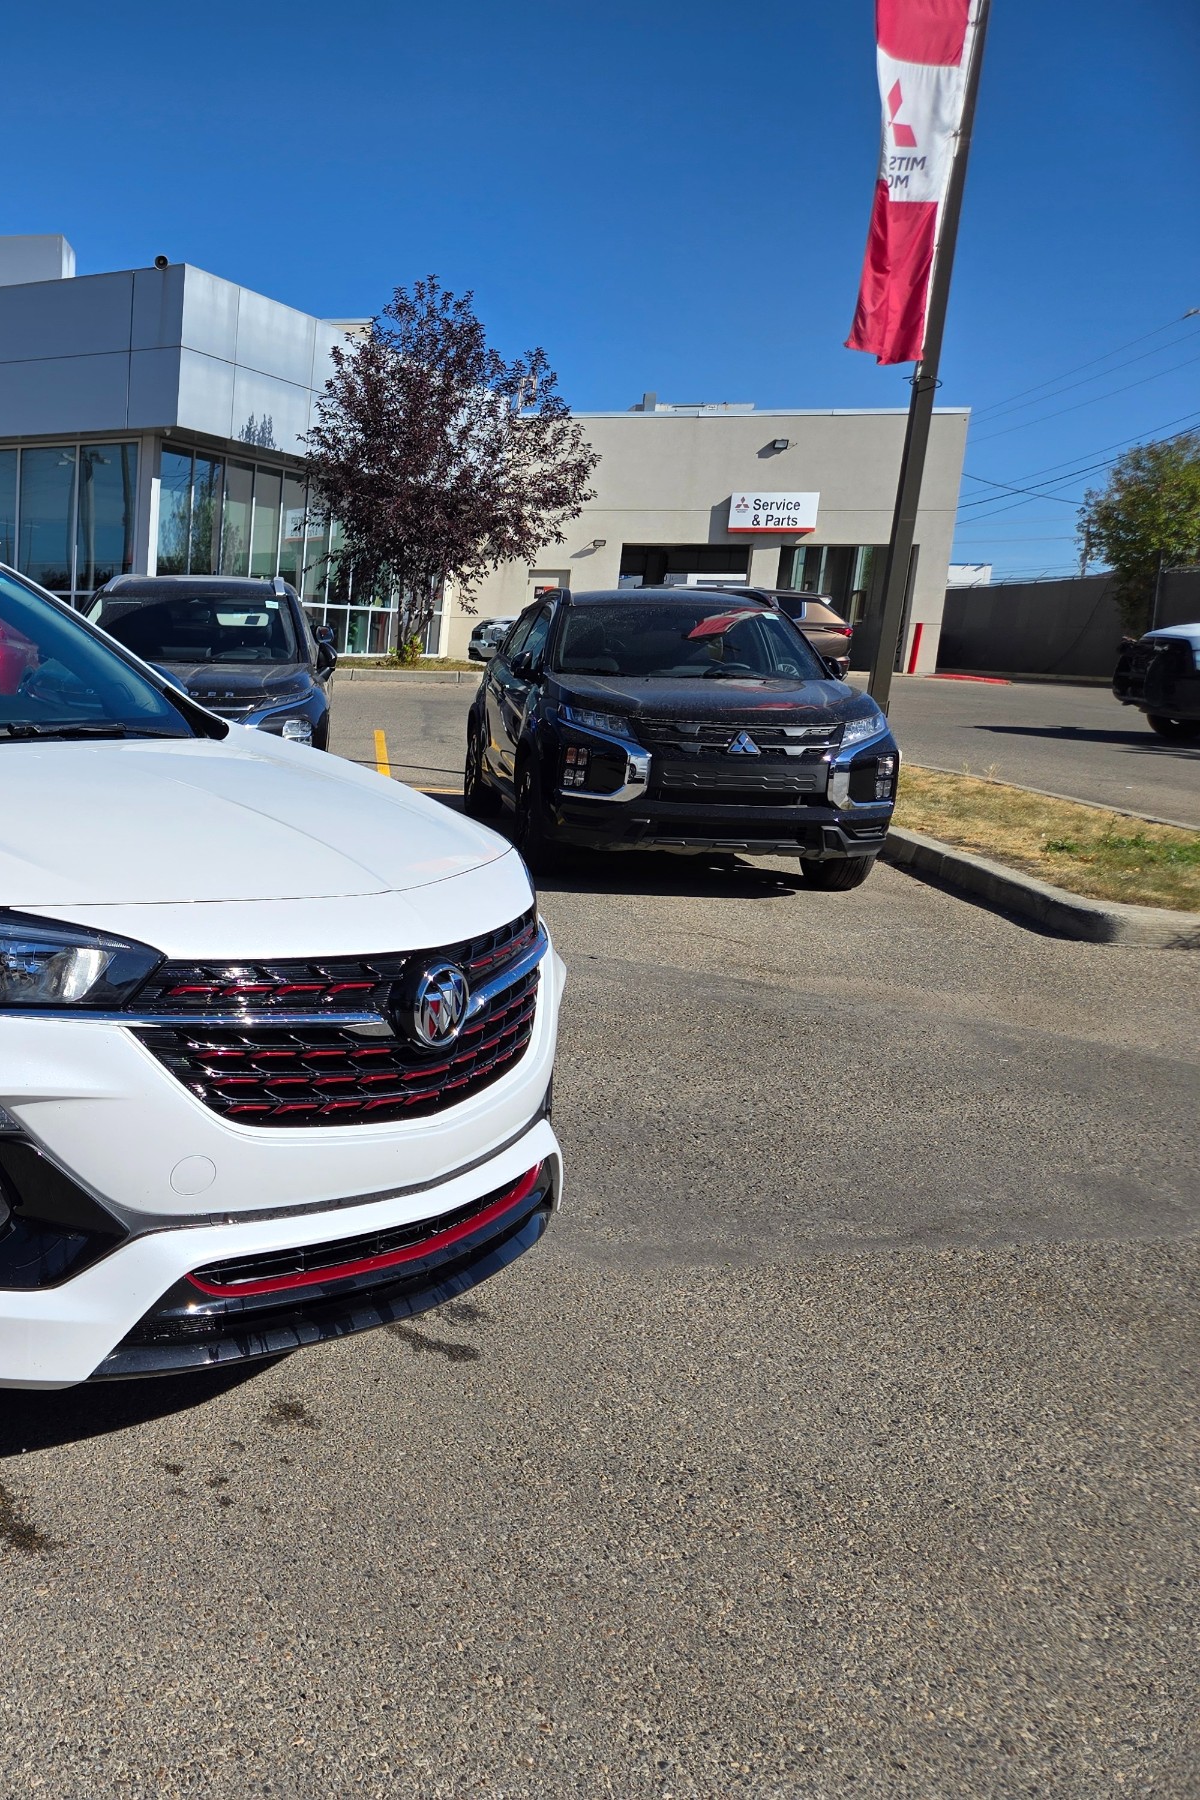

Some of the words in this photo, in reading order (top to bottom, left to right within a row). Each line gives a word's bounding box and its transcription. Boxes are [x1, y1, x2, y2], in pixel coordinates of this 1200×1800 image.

[752, 498, 801, 511] Service
[751, 514, 761, 526] &
[765, 514, 798, 526] Parts
